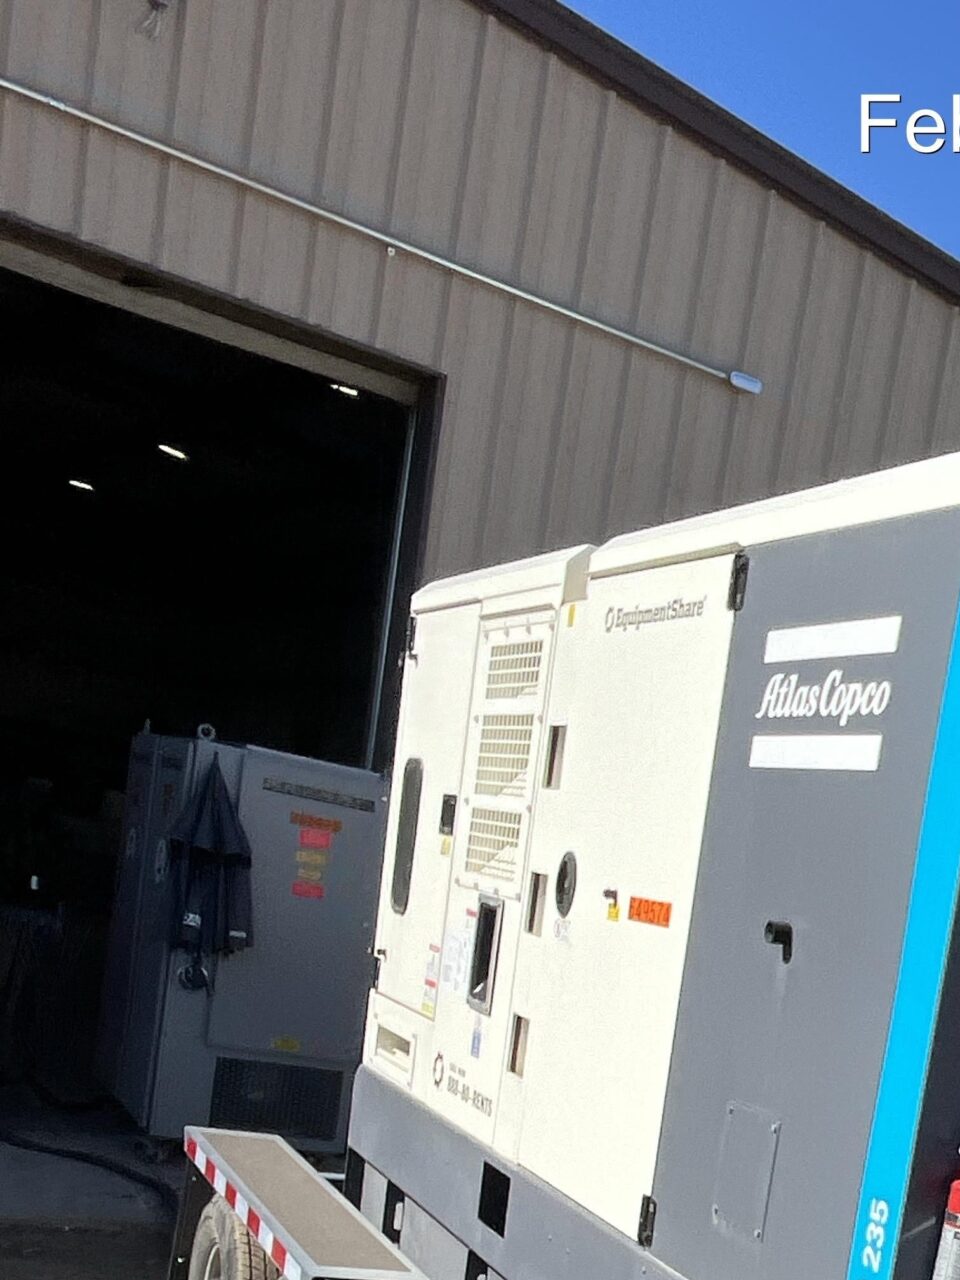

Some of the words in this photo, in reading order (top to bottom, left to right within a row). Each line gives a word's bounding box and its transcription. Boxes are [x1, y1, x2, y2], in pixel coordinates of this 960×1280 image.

[755, 672, 820, 718] Atlas
[820, 669, 891, 726] Copco
[863, 1197, 890, 1273] 235
